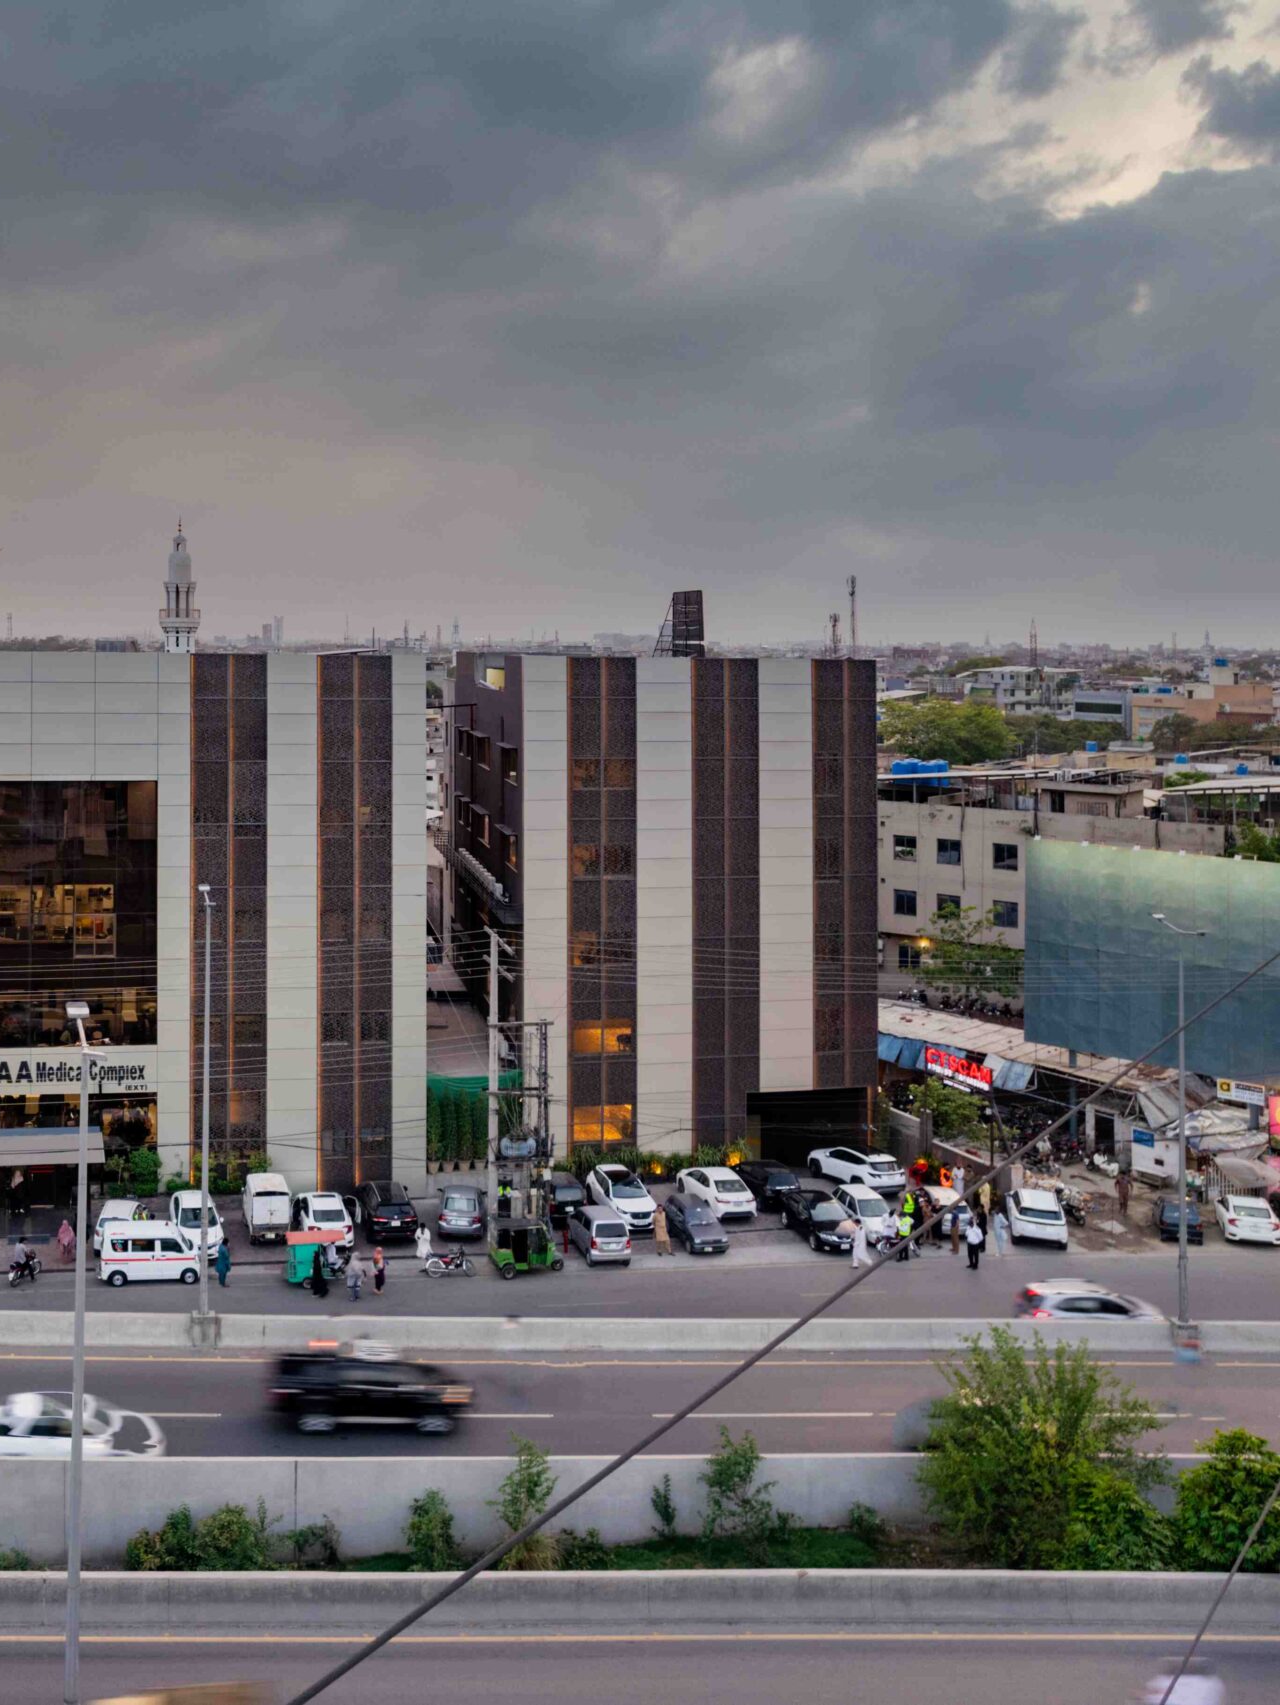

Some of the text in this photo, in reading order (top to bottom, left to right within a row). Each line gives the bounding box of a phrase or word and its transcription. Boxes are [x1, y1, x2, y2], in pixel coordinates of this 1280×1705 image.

[36, 1061, 84, 1083] Medica
[949, 1055, 992, 1085] SCAN
[125, 1084, 148, 1092] (EXT)
